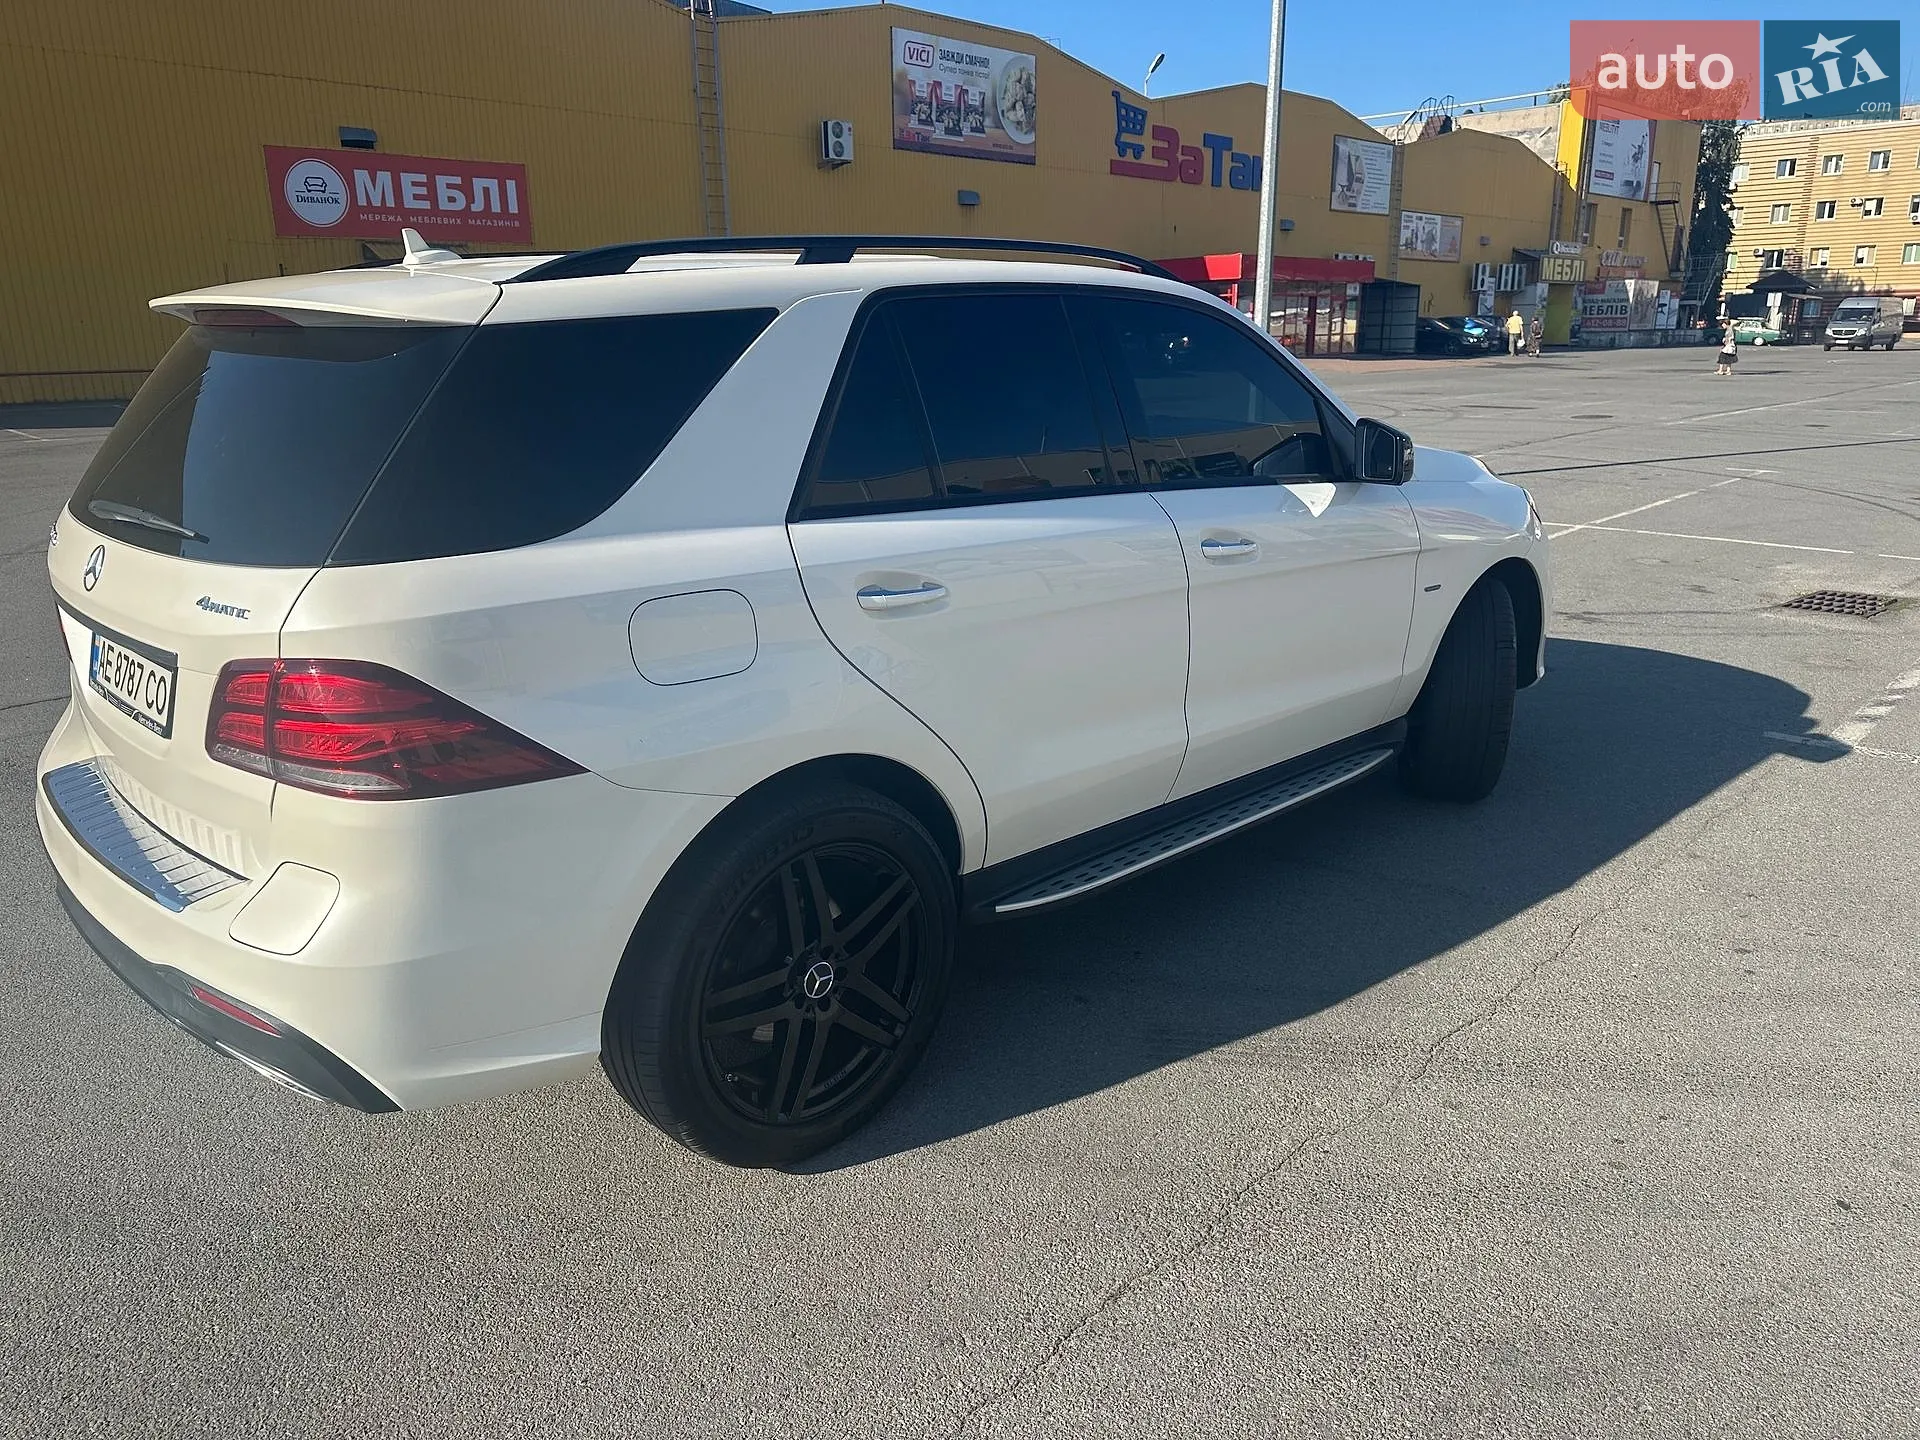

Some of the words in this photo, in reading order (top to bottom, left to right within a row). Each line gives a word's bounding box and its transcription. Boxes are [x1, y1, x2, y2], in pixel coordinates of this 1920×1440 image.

[354, 169, 519, 214] МЕБЛІ
[360, 213, 402, 222] МЕРЕЖА
[410, 215, 461, 225] МЕБЛЕВИХ
[468, 218, 520, 227] МАГАЗИНІВ
[1542, 257, 1585, 282] МЕБЛІ
[196, 595, 251, 620] 4MATIC
[99, 640, 115, 684] AE
[115, 651, 144, 700] 8787
[146, 669, 167, 716] CO
